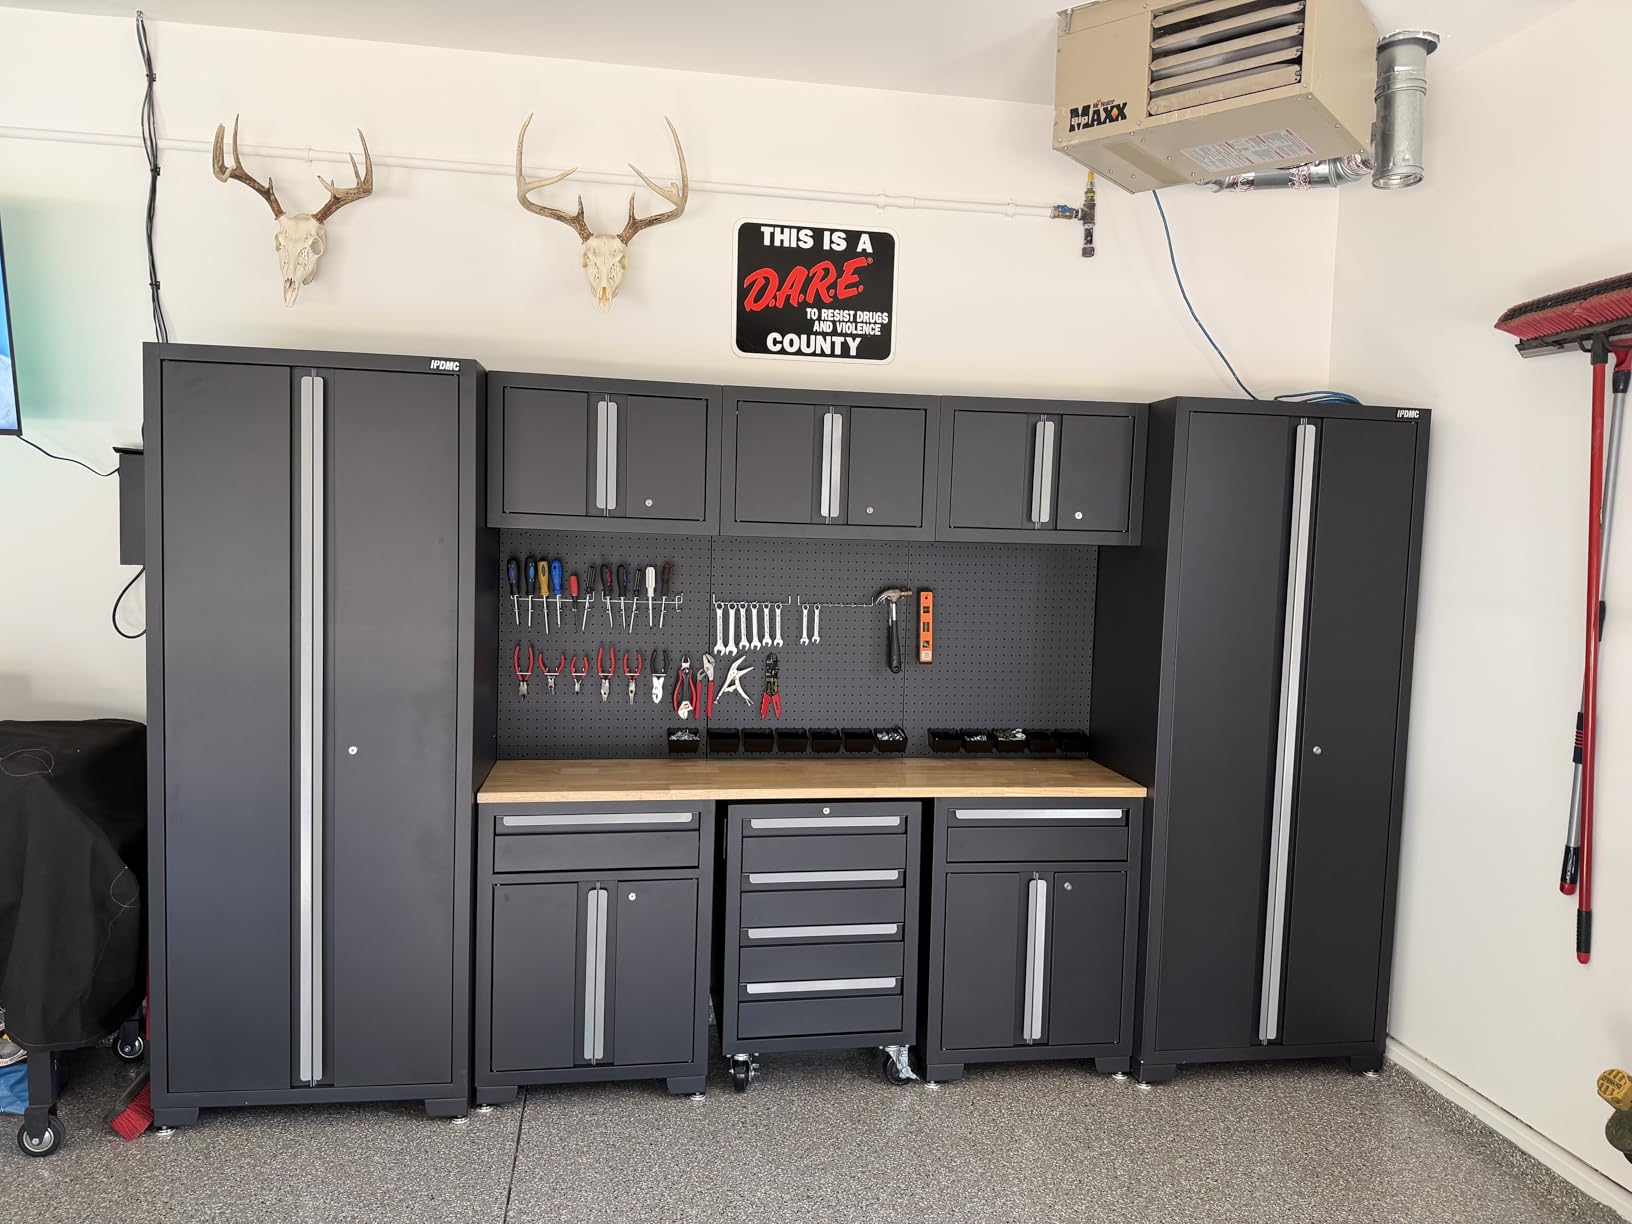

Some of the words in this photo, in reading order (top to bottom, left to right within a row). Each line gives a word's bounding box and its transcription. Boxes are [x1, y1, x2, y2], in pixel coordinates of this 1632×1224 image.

[1068, 101, 1128, 133] MAXX
[760, 226, 814, 249] THIS
[823, 230, 847, 251] IS
[856, 233, 873, 253] A
[806, 307, 819, 320] TO
[821, 308, 855, 322] RESIST
[856, 310, 889, 324] DRUGS
[813, 321, 833, 333] AND
[836, 322, 882, 336] VIOLENCE
[766, 332, 862, 356] COUNTY
